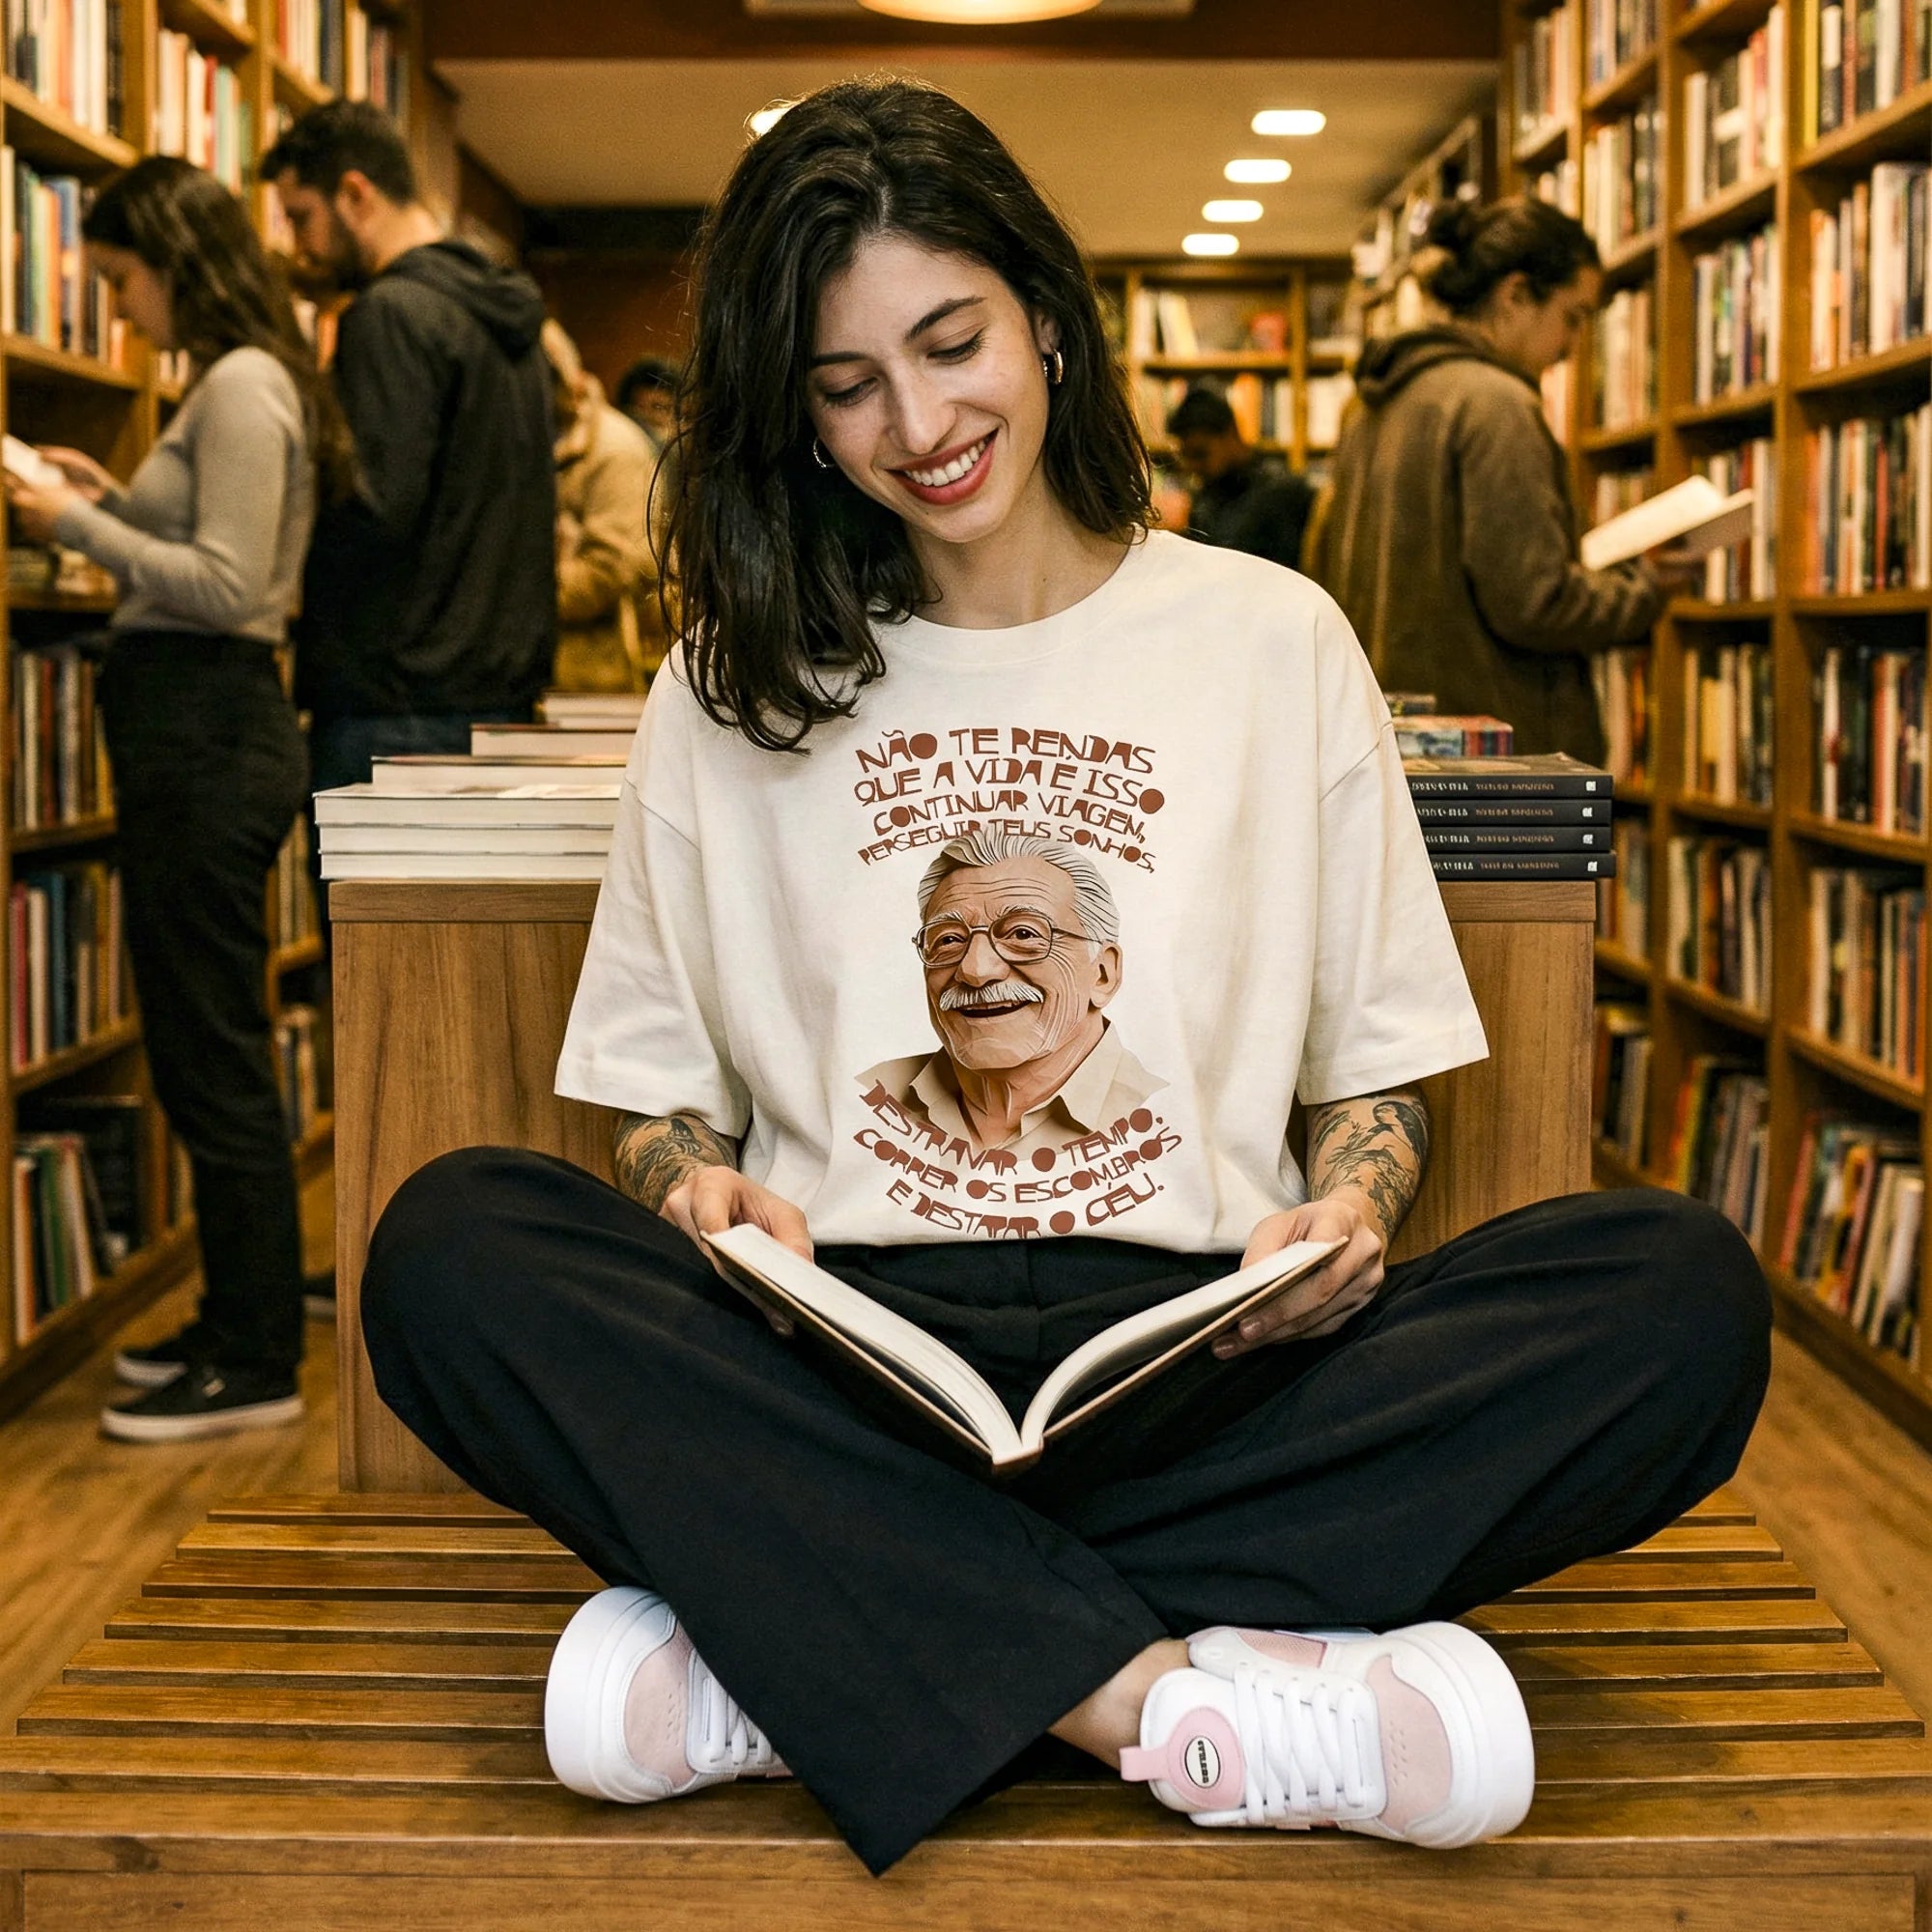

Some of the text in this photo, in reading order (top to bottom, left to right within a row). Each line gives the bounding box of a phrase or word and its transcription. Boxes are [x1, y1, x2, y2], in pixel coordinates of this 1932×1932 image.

[856, 727, 1155, 774] NÃO TE RENDAS
[854, 768, 922, 807] QUE
[933, 761, 954, 788] A
[965, 758, 1042, 785] VIDA
[1083, 769, 1164, 814] ISSO
[873, 790, 1029, 837] CONTINUAR
[858, 819, 1156, 873] PERSEGUIR TEUS SONHOS,
[859, 1079, 1163, 1176] DESTRAVAR O TEMPO.
[853, 1126, 1181, 1203] CORRER OS ESCOMBROS
[886, 1179, 913, 1205] E
[911, 1192, 1041, 1238] DESTAPAR
[1049, 1210, 1075, 1236] O
